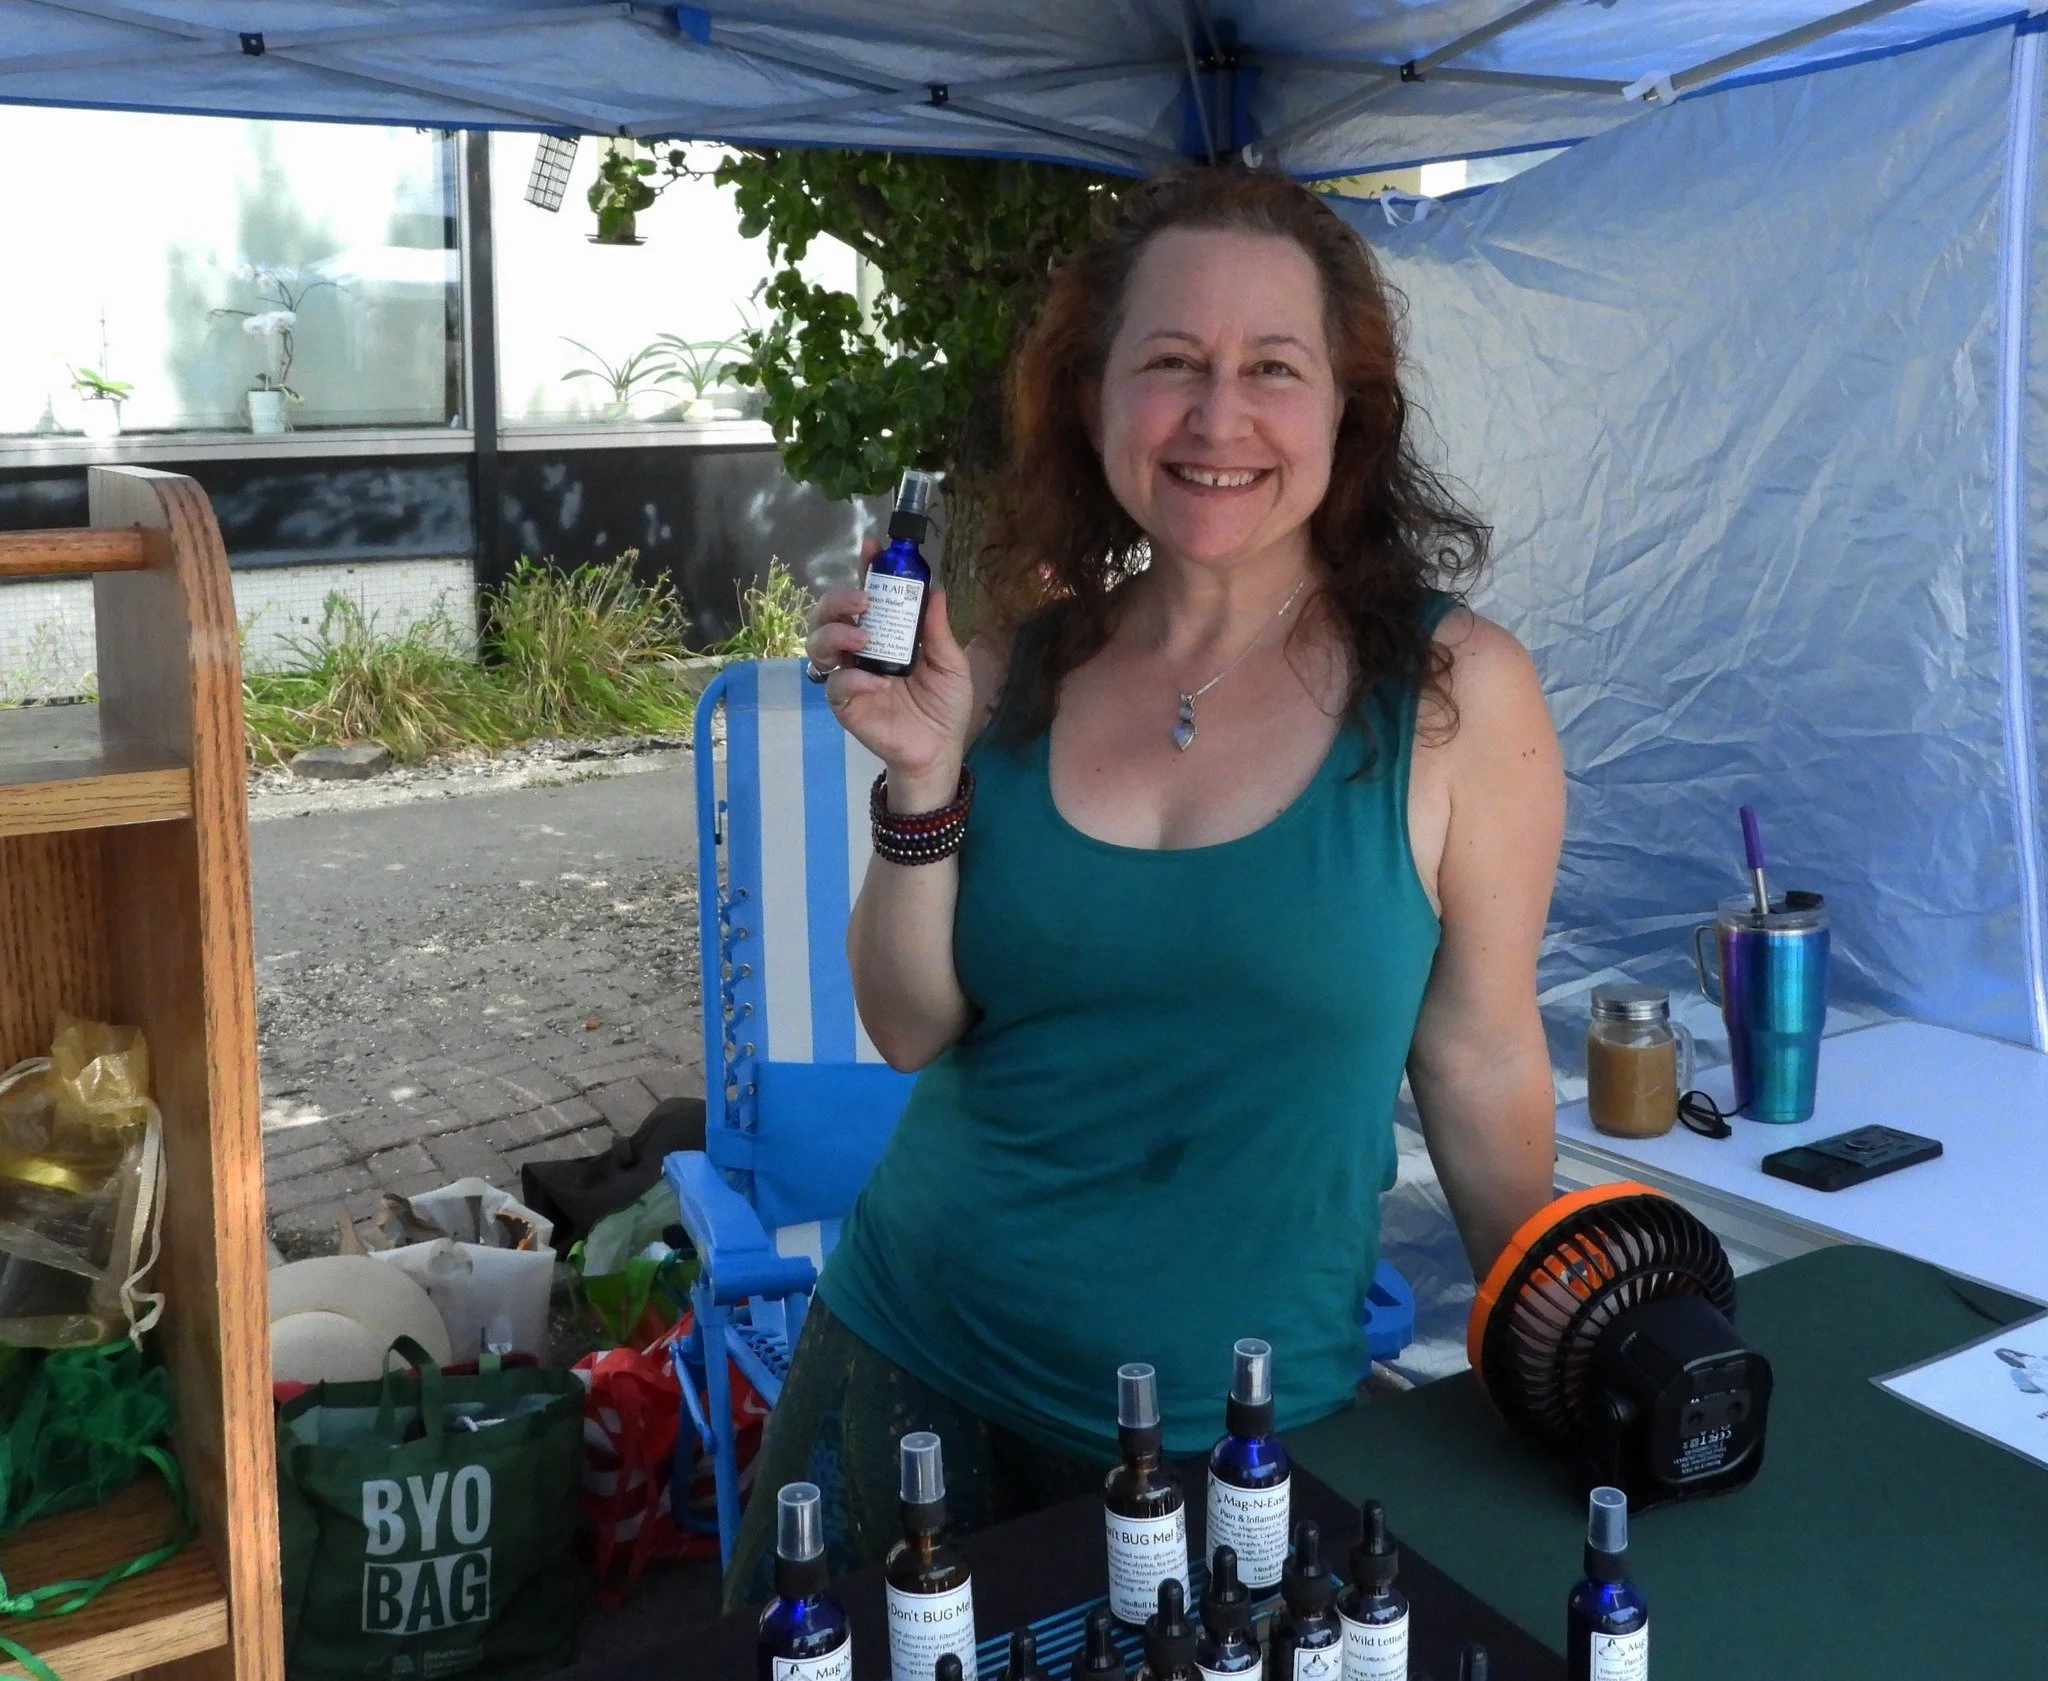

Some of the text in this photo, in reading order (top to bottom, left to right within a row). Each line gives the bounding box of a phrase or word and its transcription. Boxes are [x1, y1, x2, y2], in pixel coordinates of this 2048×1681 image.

[890, 585, 904, 595] All
[362, 1465, 491, 1556] BYO
[1238, 1514, 1244, 1523] &
[1122, 1532, 1149, 1545] BUG
[1153, 1529, 1174, 1544] Me!
[366, 1552, 488, 1632] BAG
[891, 1602, 919, 1622] Don't
[923, 1608, 953, 1623] BUG
[1350, 1632, 1374, 1646] Wild
